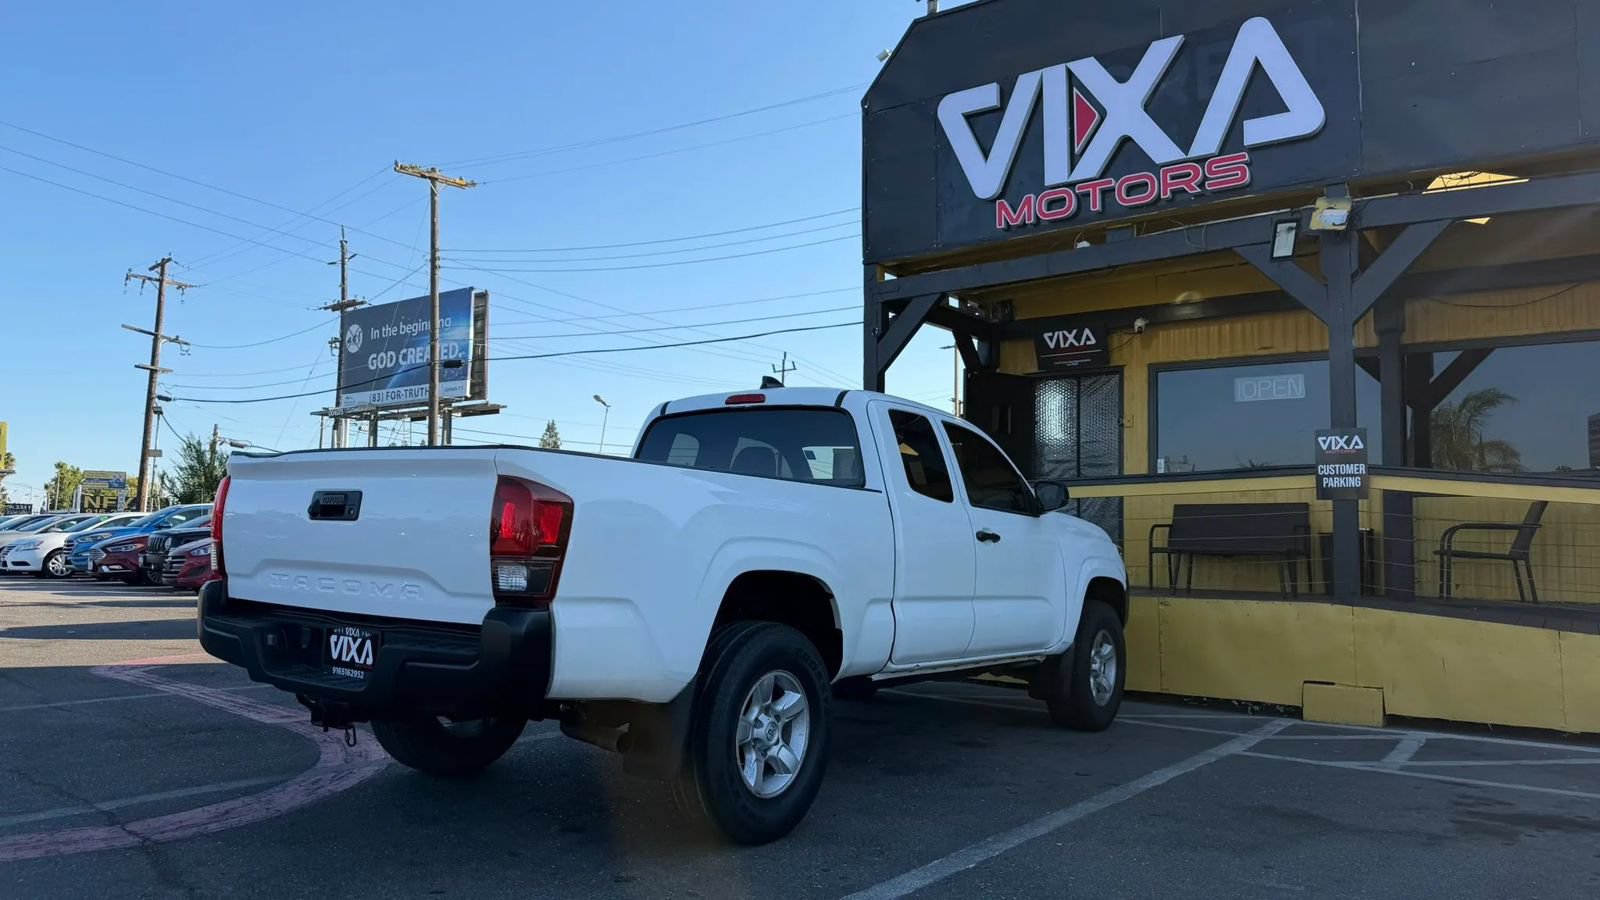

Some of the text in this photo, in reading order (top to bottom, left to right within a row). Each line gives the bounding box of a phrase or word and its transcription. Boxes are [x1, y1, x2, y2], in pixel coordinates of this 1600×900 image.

[937, 16, 1326, 200] VIXA
[995, 152, 1250, 230] MOTORS
[371, 317, 452, 340] In the beginng
[1043, 328, 1097, 349] VIXA
[368, 343, 462, 370] GOD CREAED.
[369, 391, 384, 403] (83)
[1241, 378, 1302, 399] OPEN
[1317, 435, 1364, 450] VIXA
[1318, 464, 1365, 475] CUSTOMER
[1323, 477, 1361, 488] PARKING
[269, 573, 425, 600] TACOMA
[345, 626, 360, 637] VIXA
[330, 634, 374, 666] VIXA
